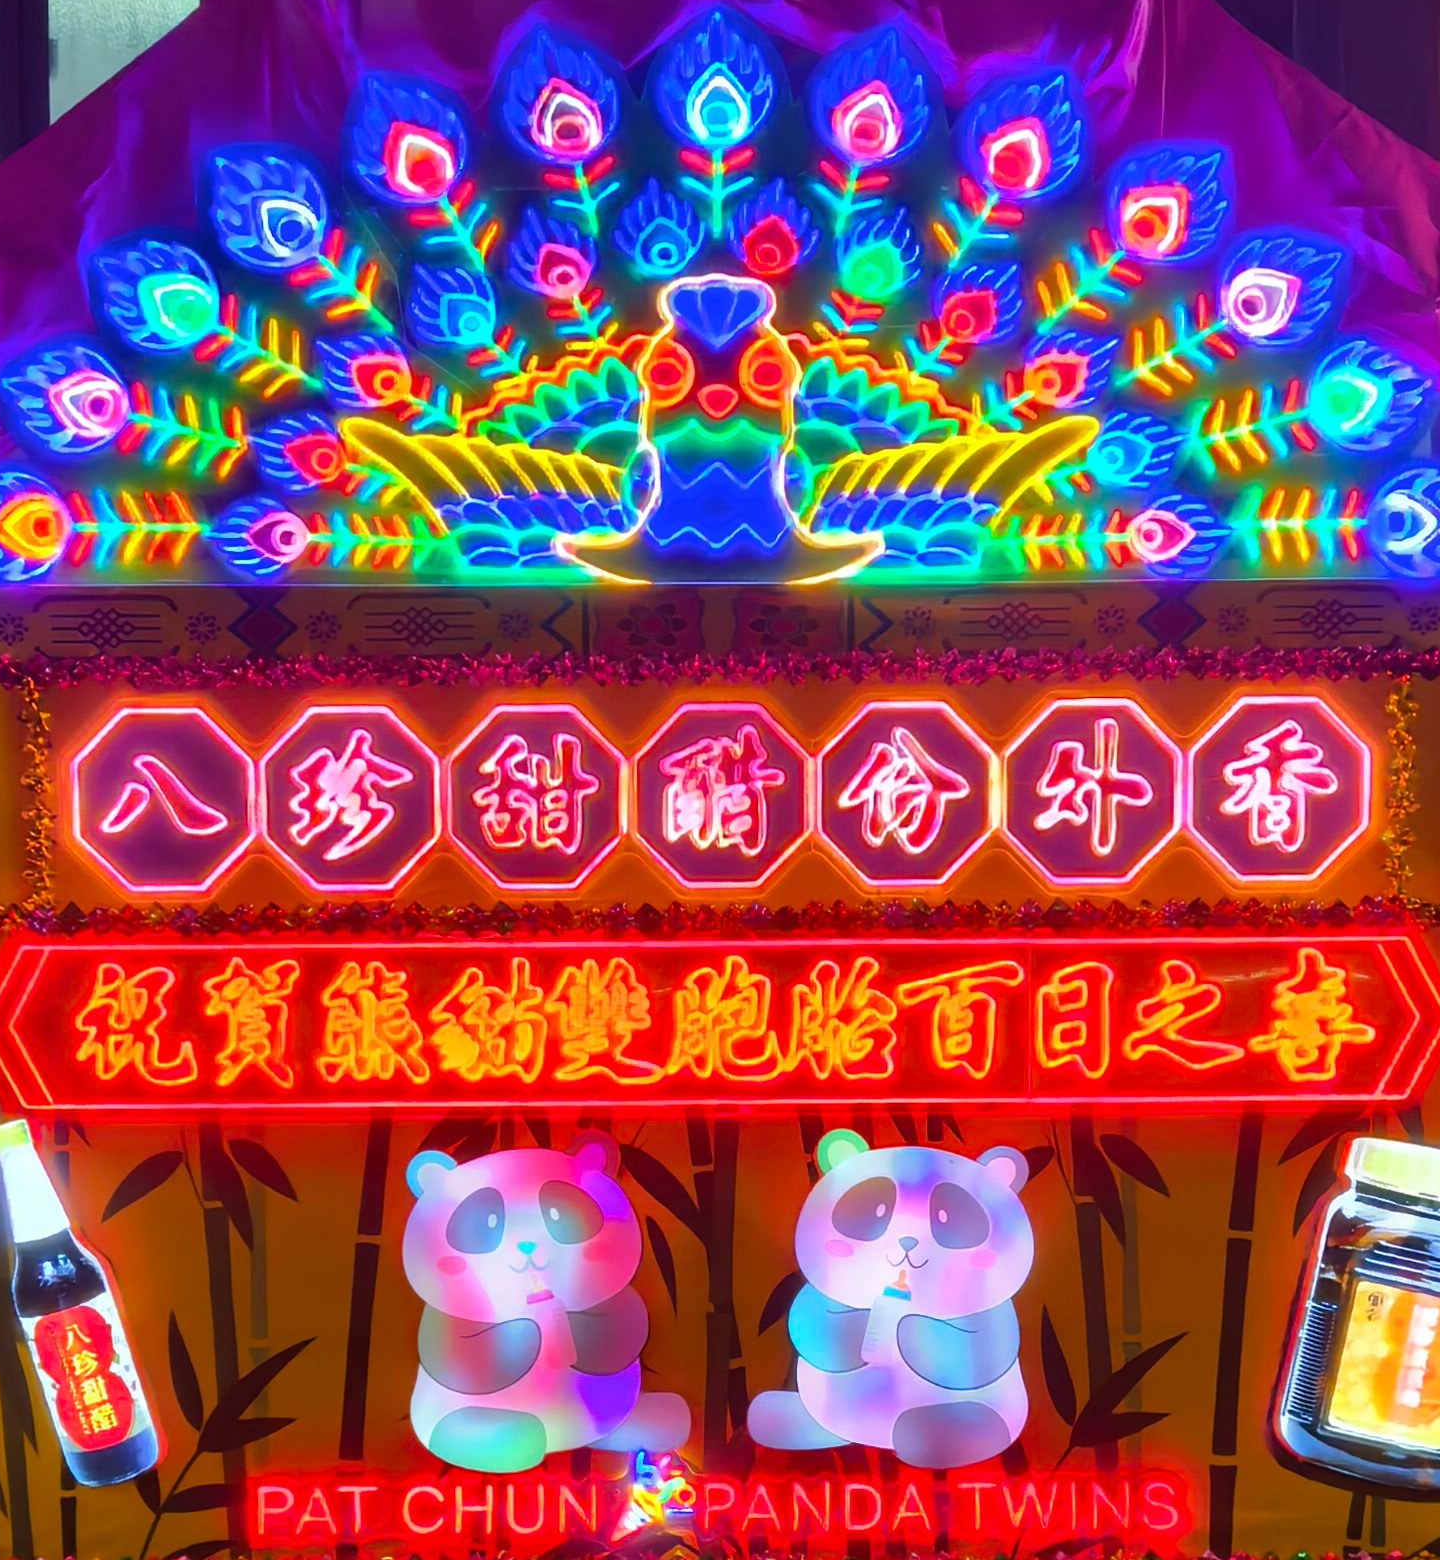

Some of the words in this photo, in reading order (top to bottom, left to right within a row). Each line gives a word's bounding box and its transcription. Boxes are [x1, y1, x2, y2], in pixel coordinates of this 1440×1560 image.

[98, 716, 1339, 861] 八珍甜醋份外香
[256, 1485, 378, 1535] PAT
[402, 1483, 598, 1536] CHUN
[703, 1481, 931, 1532] PANDA
[957, 1481, 1180, 1531] TWINS
